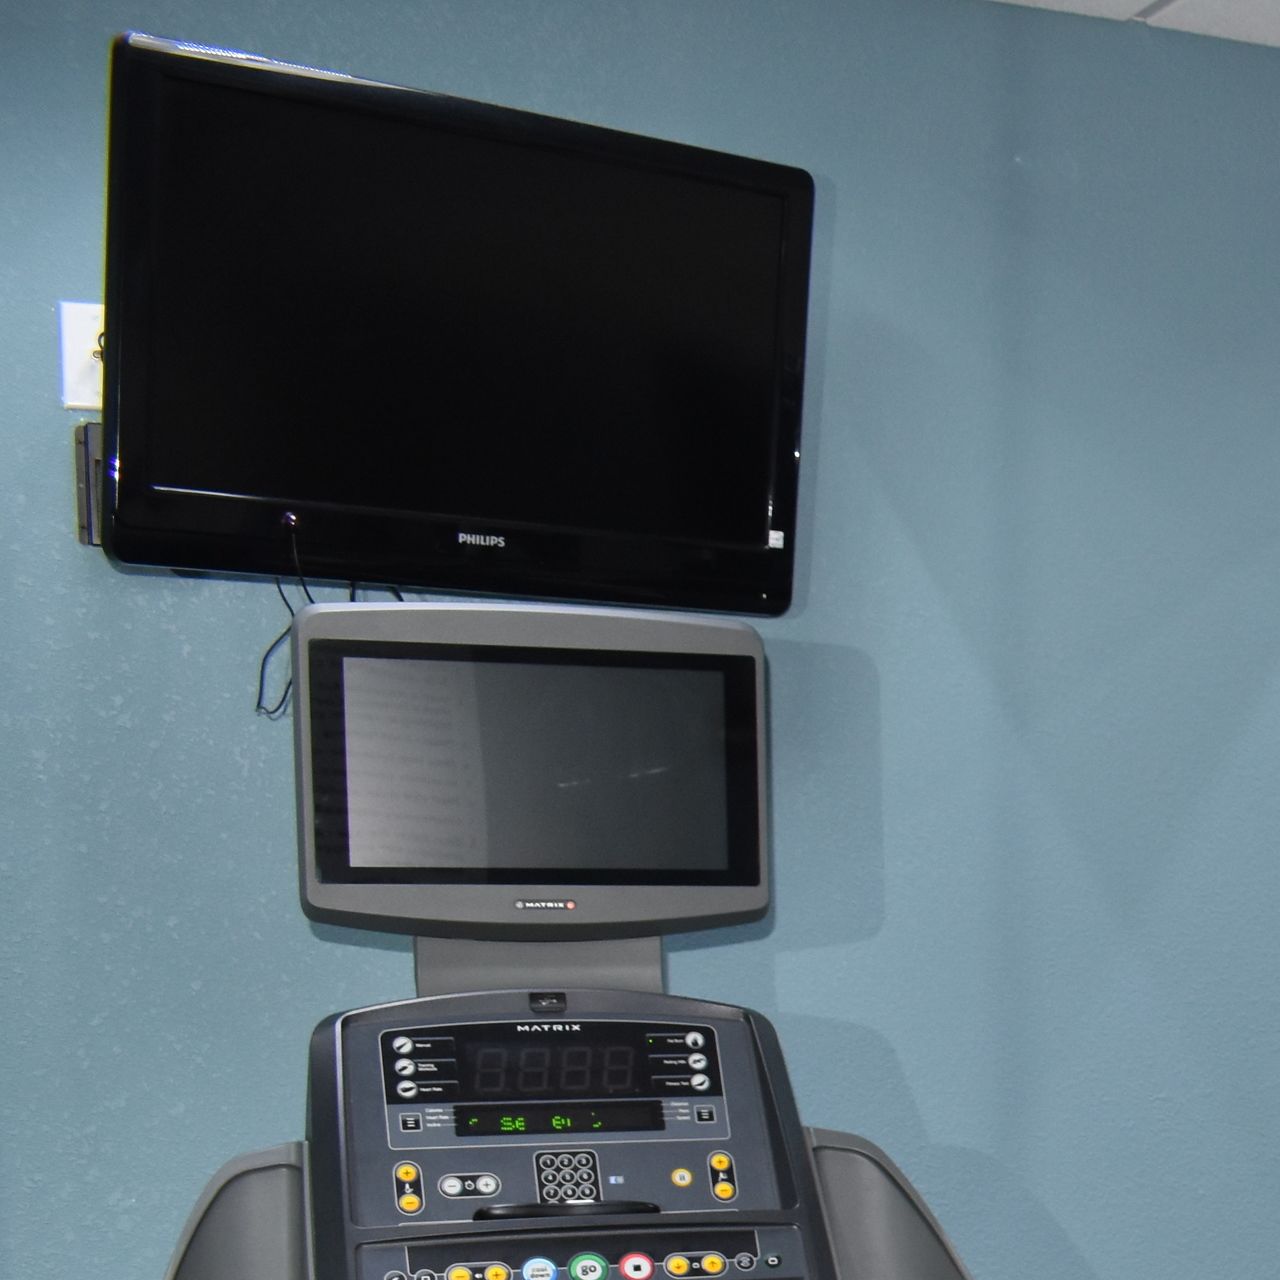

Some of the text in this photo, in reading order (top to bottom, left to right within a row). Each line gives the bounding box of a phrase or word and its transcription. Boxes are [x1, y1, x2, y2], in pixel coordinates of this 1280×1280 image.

[458, 532, 506, 547] PHILIPS
[516, 1024, 581, 1032] MATRIX
[580, 1264, 597, 1276] go
